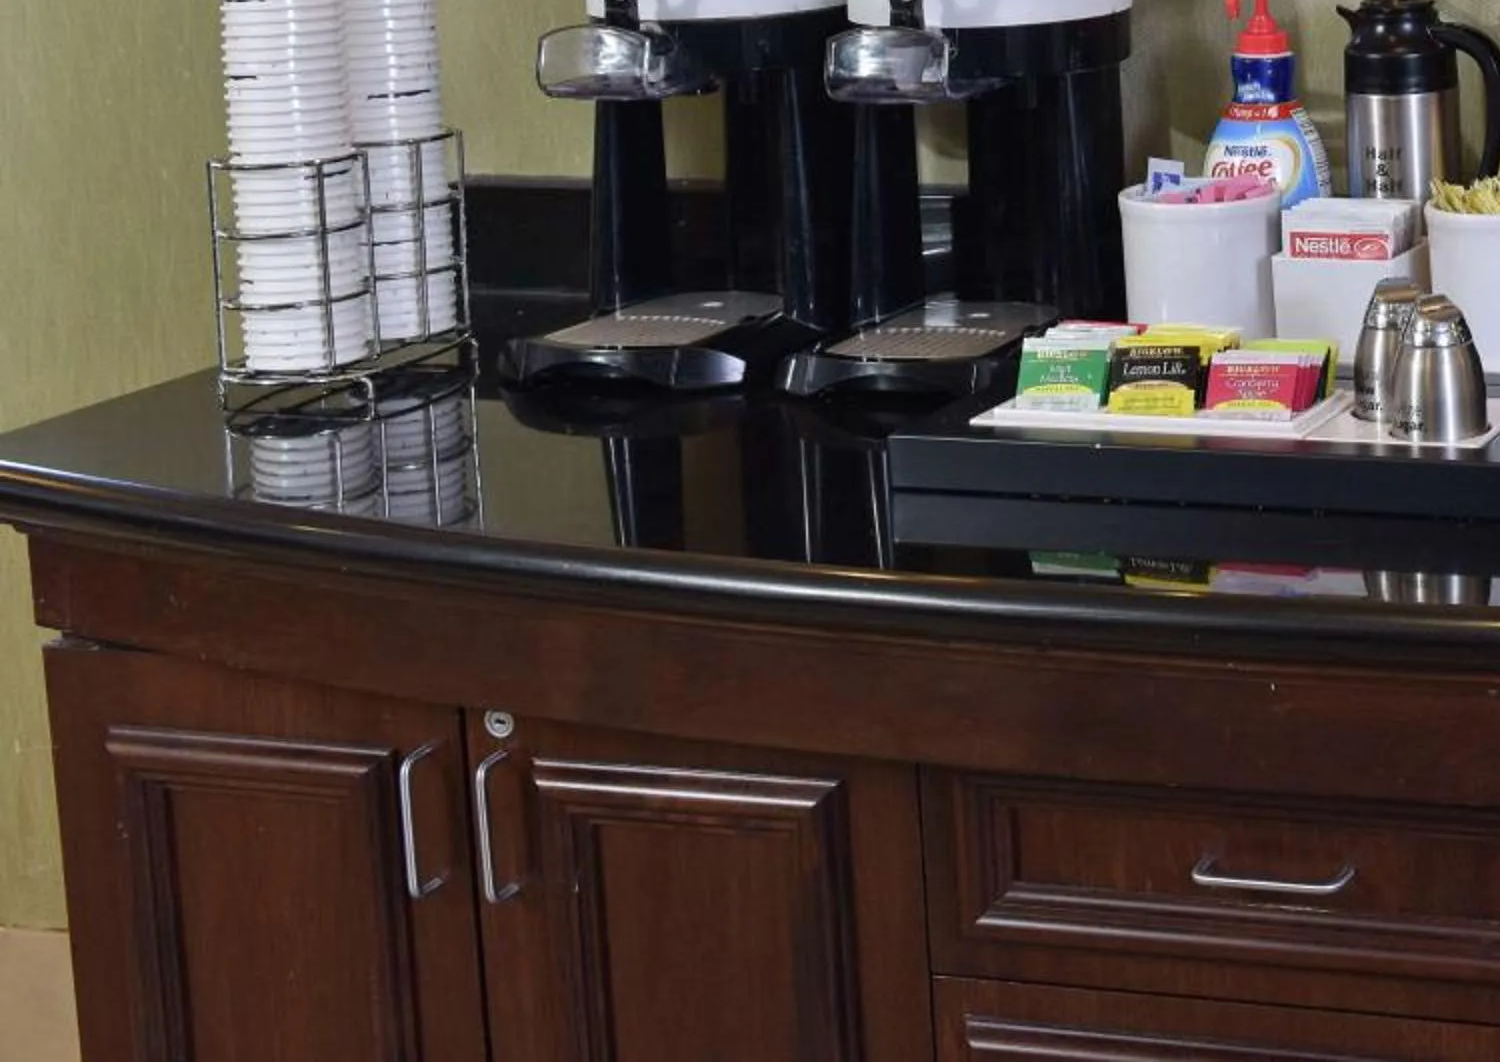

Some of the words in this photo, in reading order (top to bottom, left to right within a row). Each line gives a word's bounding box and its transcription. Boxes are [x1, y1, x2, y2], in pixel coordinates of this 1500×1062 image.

[1376, 163, 1391, 177] &
[1295, 236, 1352, 255] Nestlé
[1123, 360, 1161, 376] Lemon
